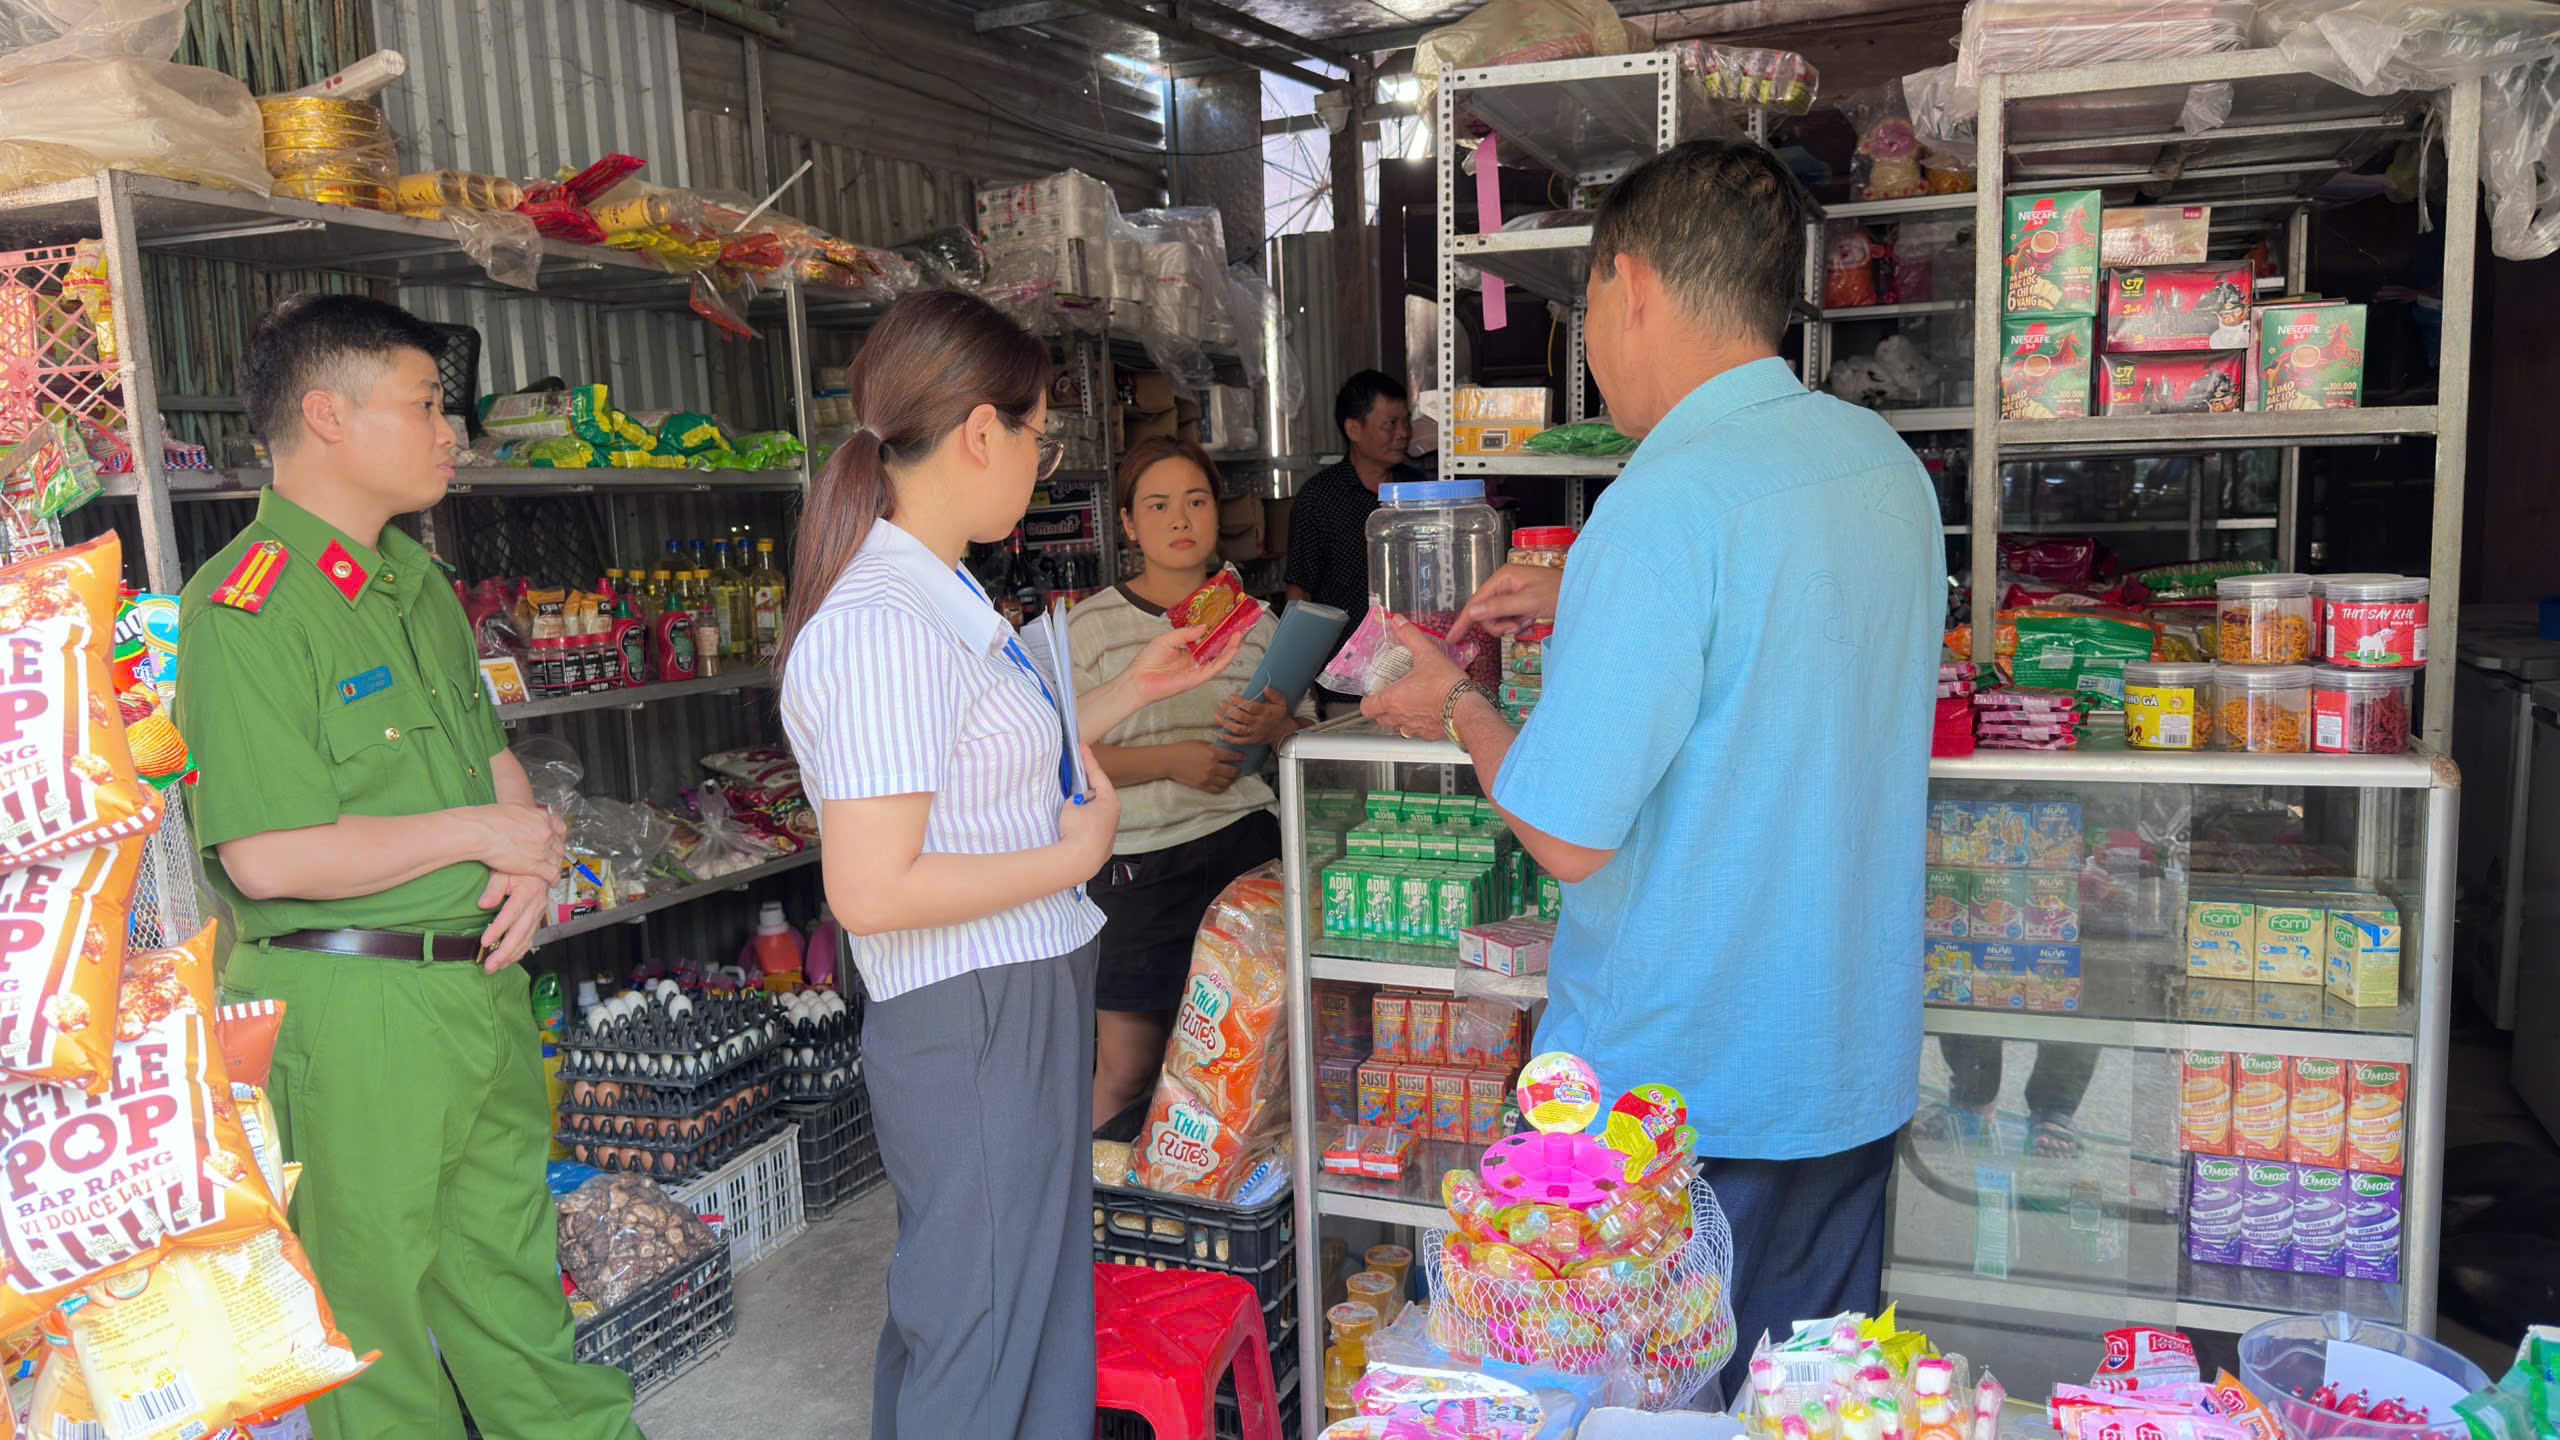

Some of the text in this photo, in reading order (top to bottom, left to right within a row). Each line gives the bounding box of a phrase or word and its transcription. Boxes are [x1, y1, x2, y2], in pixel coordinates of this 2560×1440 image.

[2121, 277, 2144, 291] G7
[2007, 291, 2017, 312] 6
[2112, 365, 2135, 378] G7
[1026, 516, 1079, 536] Omachi
[1329, 876, 1352, 890] ADM
[1366, 878, 1391, 892] ADM
[1403, 881, 1428, 896] ADM
[1440, 885, 1466, 899] ADM
[2208, 929, 2234, 937] CANXI
[2276, 935, 2304, 943] CANXI
[1375, 1000, 1405, 1015] SUSU
[1411, 1002, 1442, 1017] SUSU
[1361, 1071, 1388, 1087] SUSU
[1397, 1075, 1425, 1091] SUSU
[1433, 1078, 1462, 1094] SUSU
[1471, 1081, 1500, 1098] SUSU
[5, 1094, 178, 1202] POP
[84, 1151, 173, 1198] RANG
[48, 1194, 118, 1231] DOLCE
